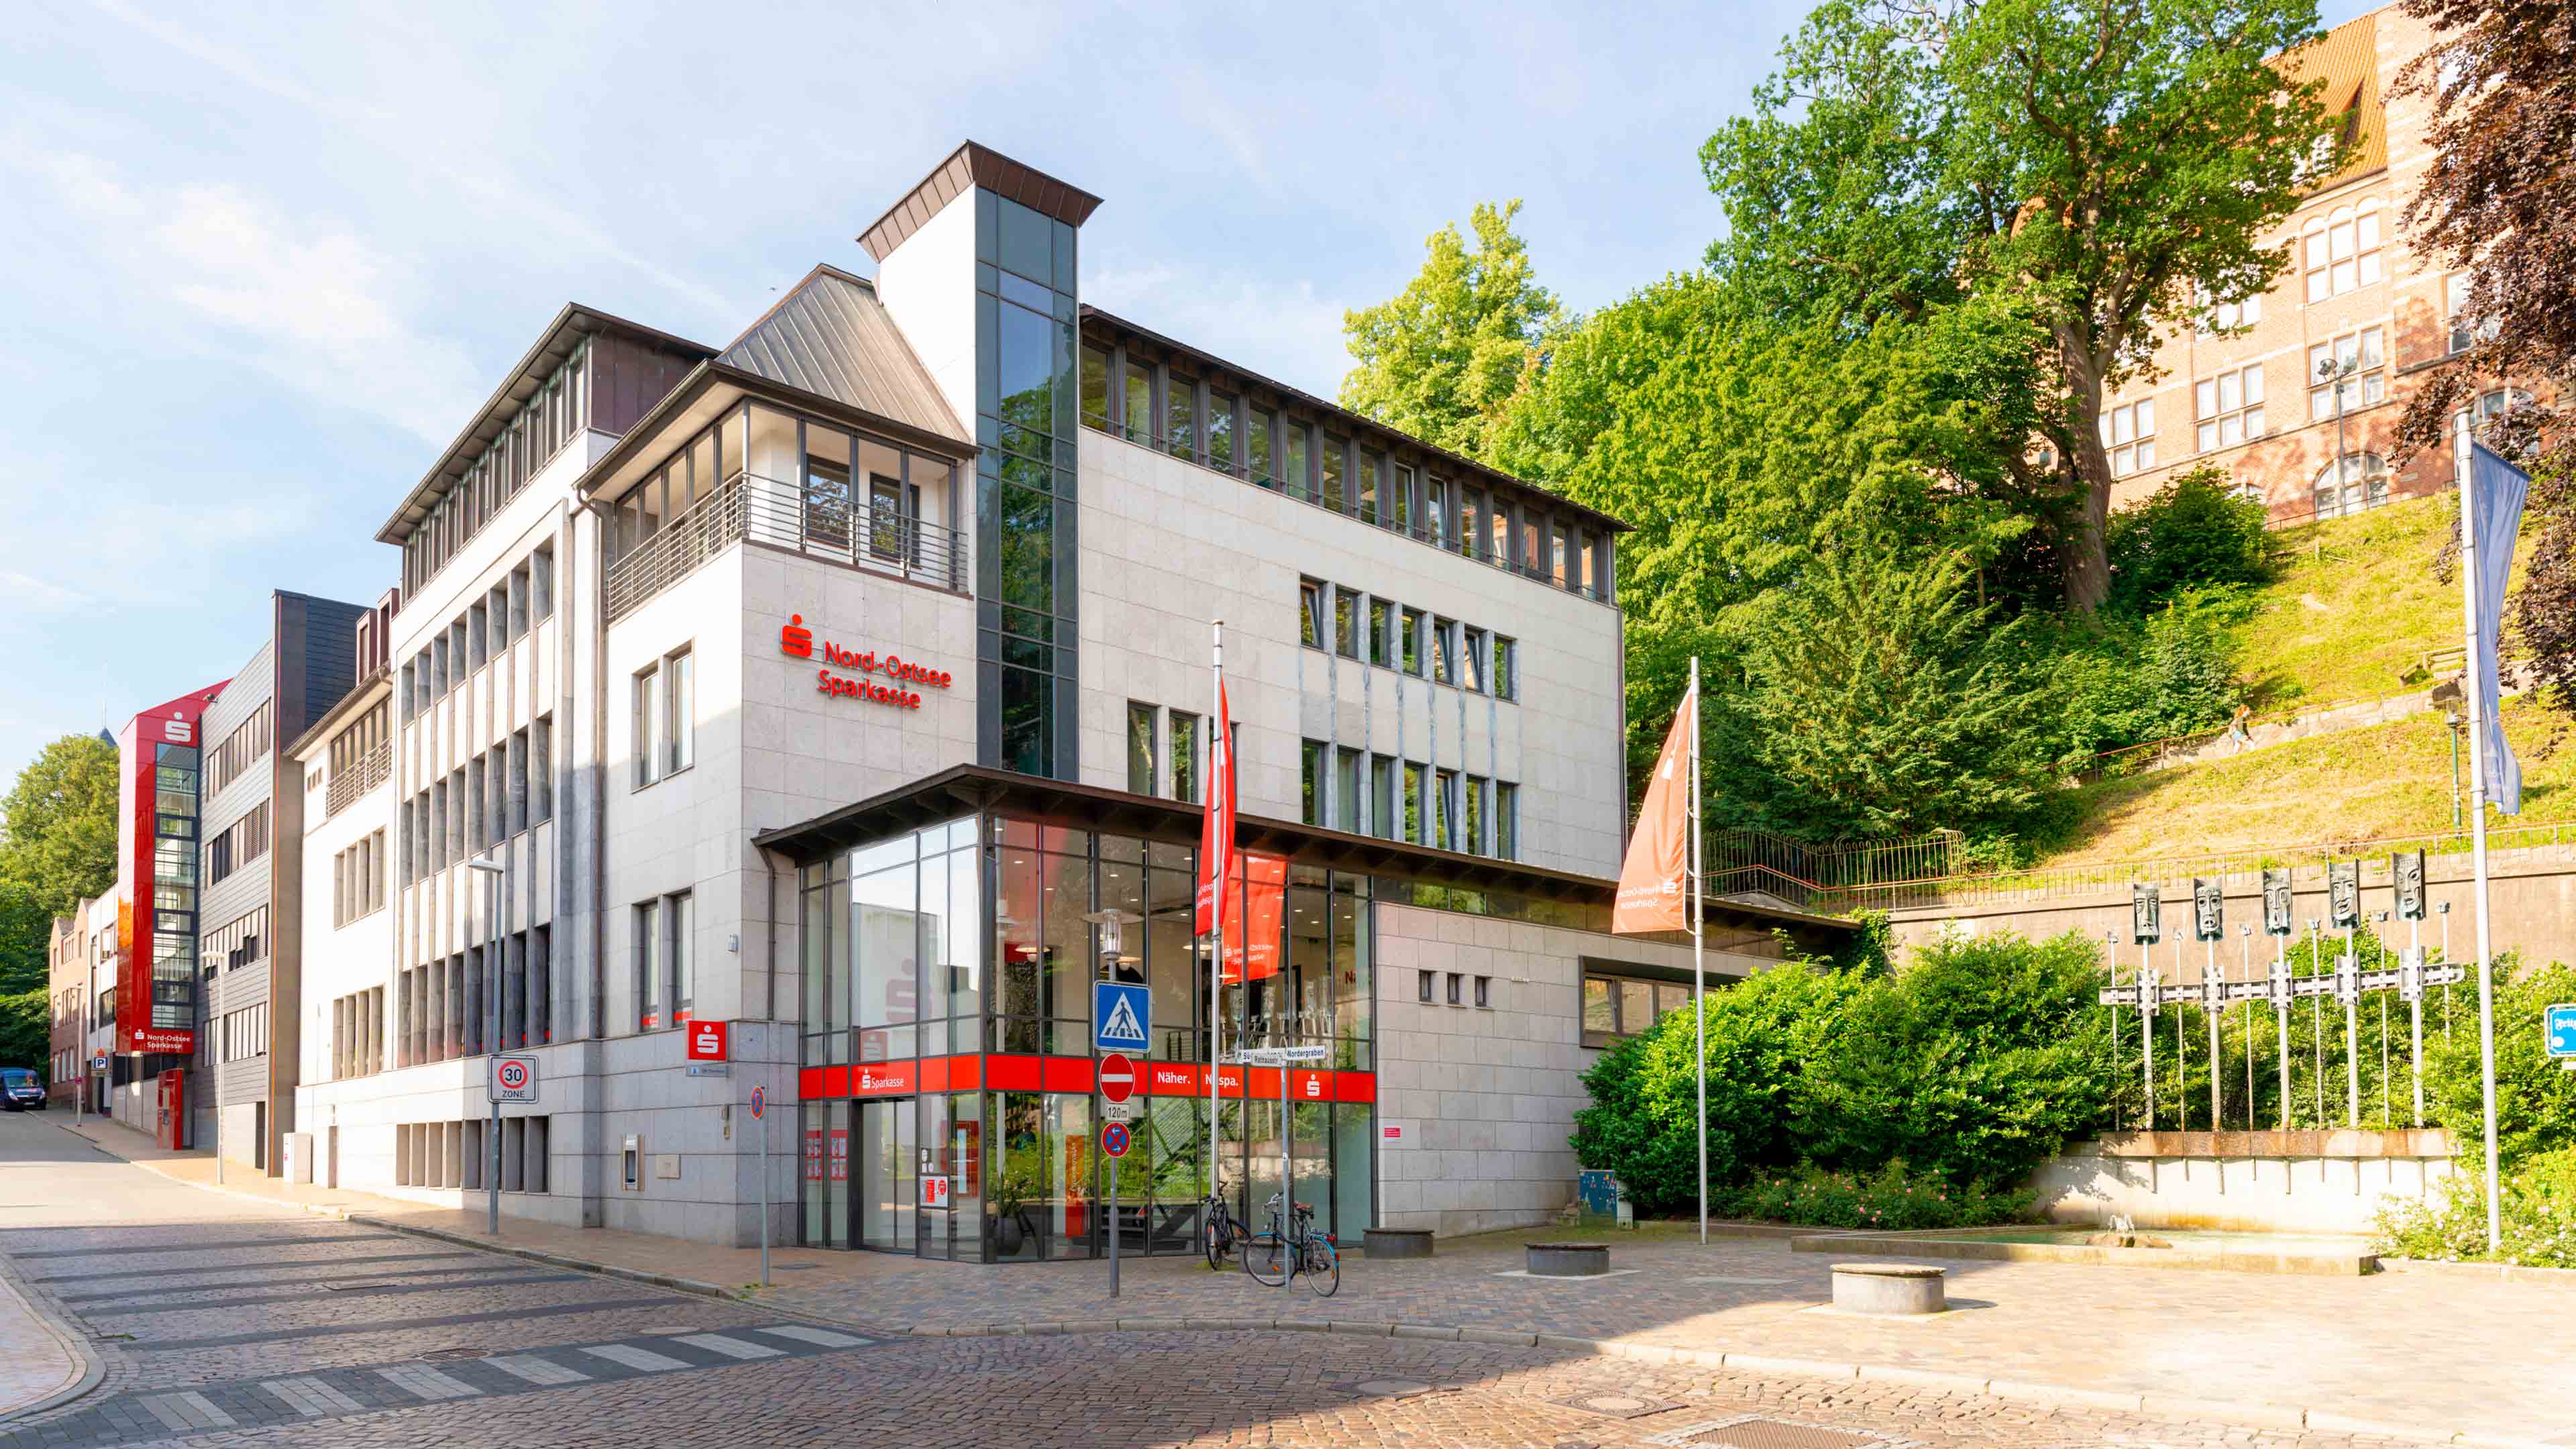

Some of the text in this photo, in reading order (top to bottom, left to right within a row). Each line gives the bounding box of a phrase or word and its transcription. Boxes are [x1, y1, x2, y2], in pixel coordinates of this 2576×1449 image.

[825, 641, 952, 688] Nord-Ostsee
[818, 669, 921, 709] Sparkasse
[147, 1034, 191, 1042] Nord-Ostsee
[1287, 1049, 1324, 1059] Nordergraben
[504, 1068, 522, 1081] 30
[1157, 1071, 1191, 1085] Näher.
[1205, 1073, 1239, 1088] Nspa.
[871, 1075, 904, 1090] Sparkasse
